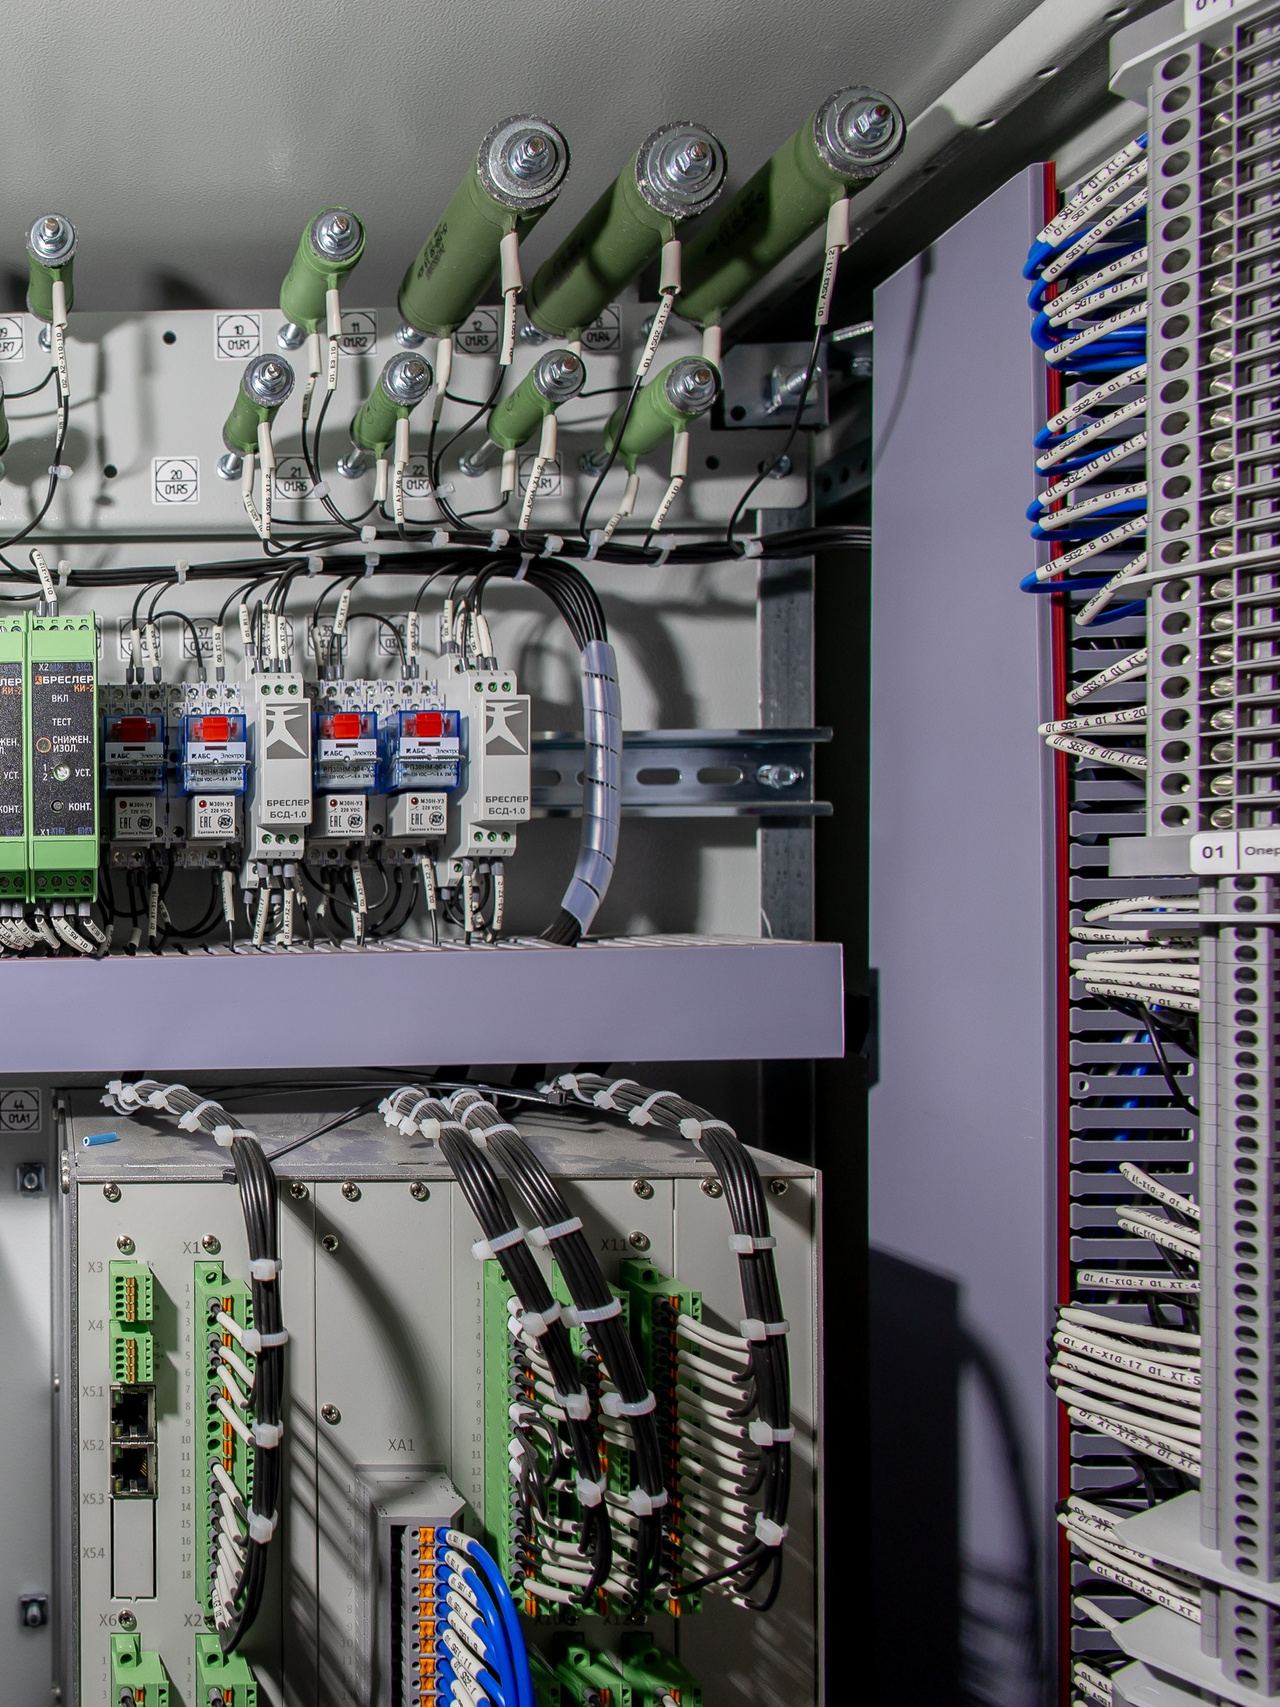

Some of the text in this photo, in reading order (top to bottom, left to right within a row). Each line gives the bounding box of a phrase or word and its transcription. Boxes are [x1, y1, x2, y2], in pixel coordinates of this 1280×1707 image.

[234, 325, 244, 336] 10
[170, 470, 182, 480] 20
[43, 676, 93, 684] БРЕСЛЕР
[52, 718, 71, 726] ТЕСТ
[266, 799, 310, 807] БРЕСЛЕР
[485, 795, 529, 803] БРЕСЛЕР
[270, 811, 306, 819] БСД-1.0
[488, 807, 525, 816] БСД-1.0
[1201, 846, 1224, 859] 01
[13, 1099, 24, 1109] 44
[183, 1242, 201, 1254] X1
[600, 1239, 627, 1251] X11
[88, 1261, 103, 1273] X3
[88, 1320, 104, 1330] X4
[82, 1386, 104, 1397] X5.1
[82, 1440, 104, 1451] X5.2
[388, 1438, 415, 1451] XA1
[83, 1493, 105, 1505] X5.3
[82, 1547, 105, 1559] X5.4
[99, 1614, 117, 1626] X6
[184, 1614, 202, 1627] X2
